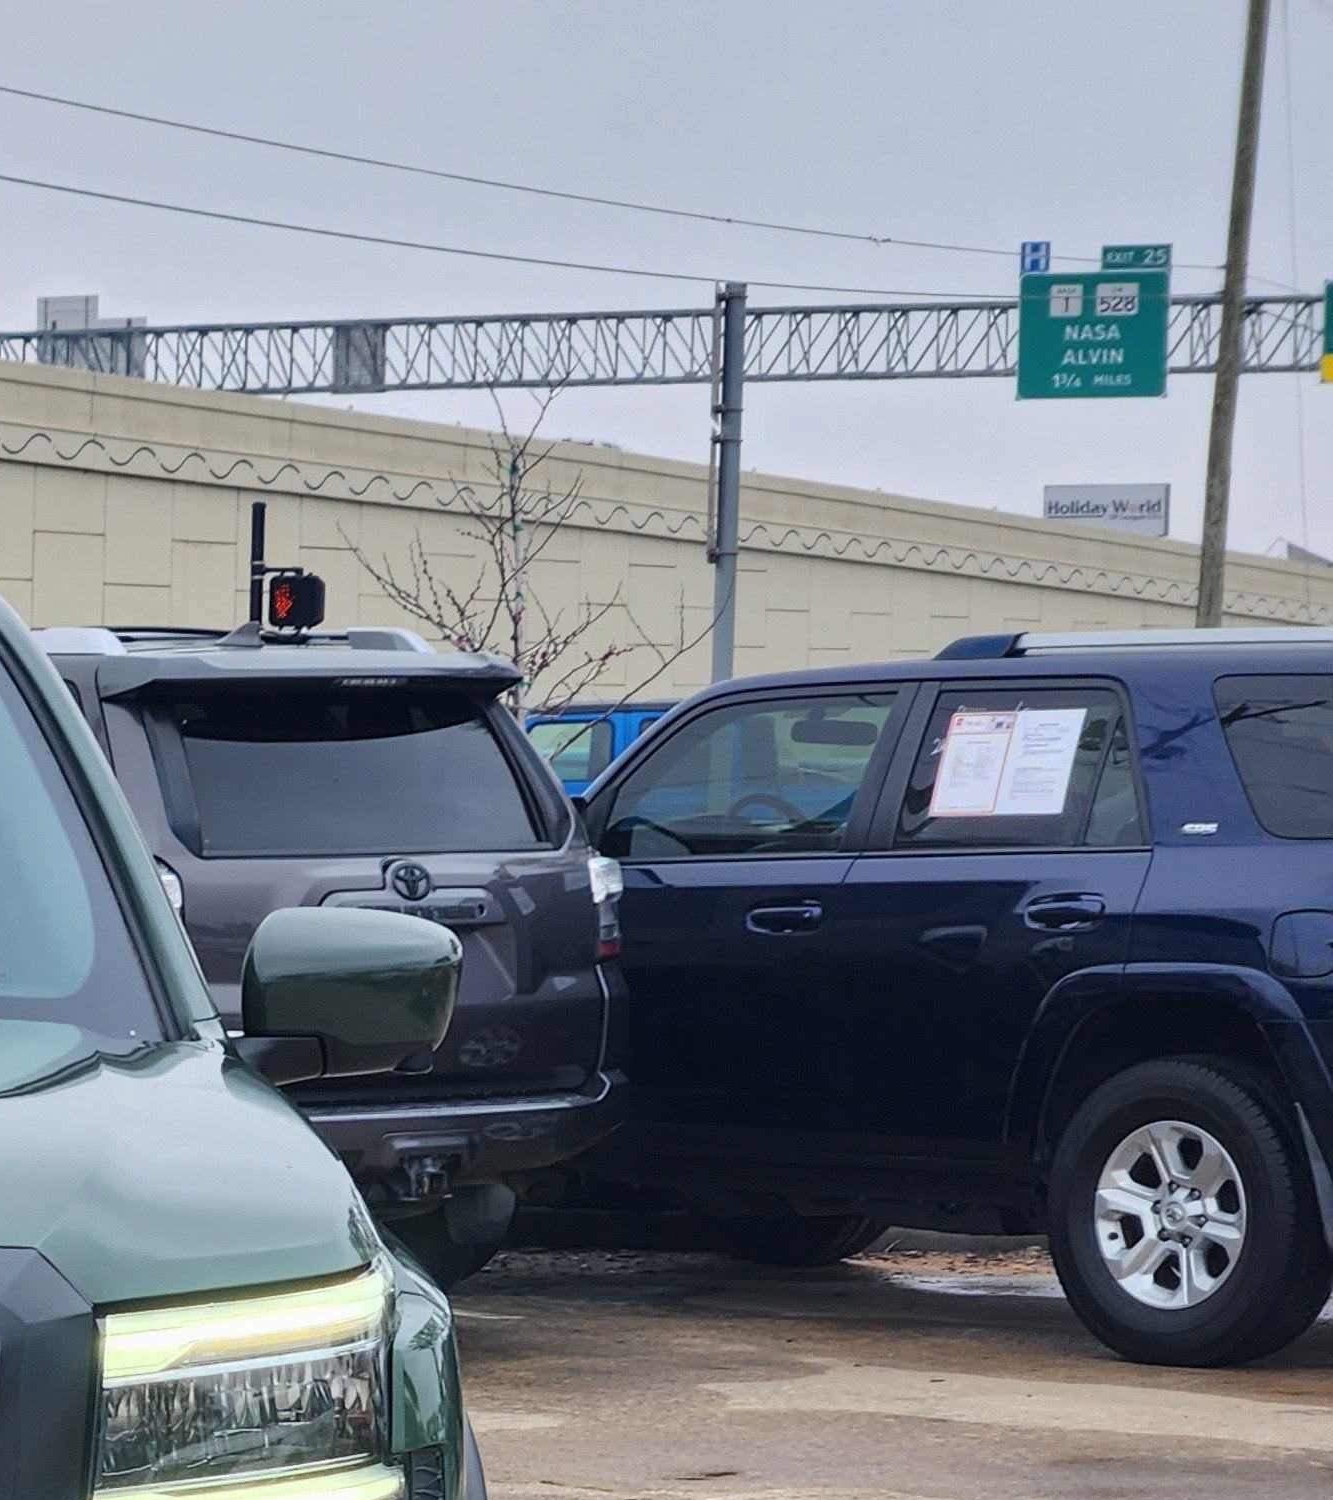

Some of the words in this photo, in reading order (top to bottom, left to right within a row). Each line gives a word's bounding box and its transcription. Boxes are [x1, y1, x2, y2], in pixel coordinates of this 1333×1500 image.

[1100, 296, 1135, 312] 528
[1064, 324, 1121, 341] NASA
[1060, 348, 1124, 365] ALVIN
[1093, 374, 1132, 386] MILES
[1048, 500, 1109, 514] Holiday
